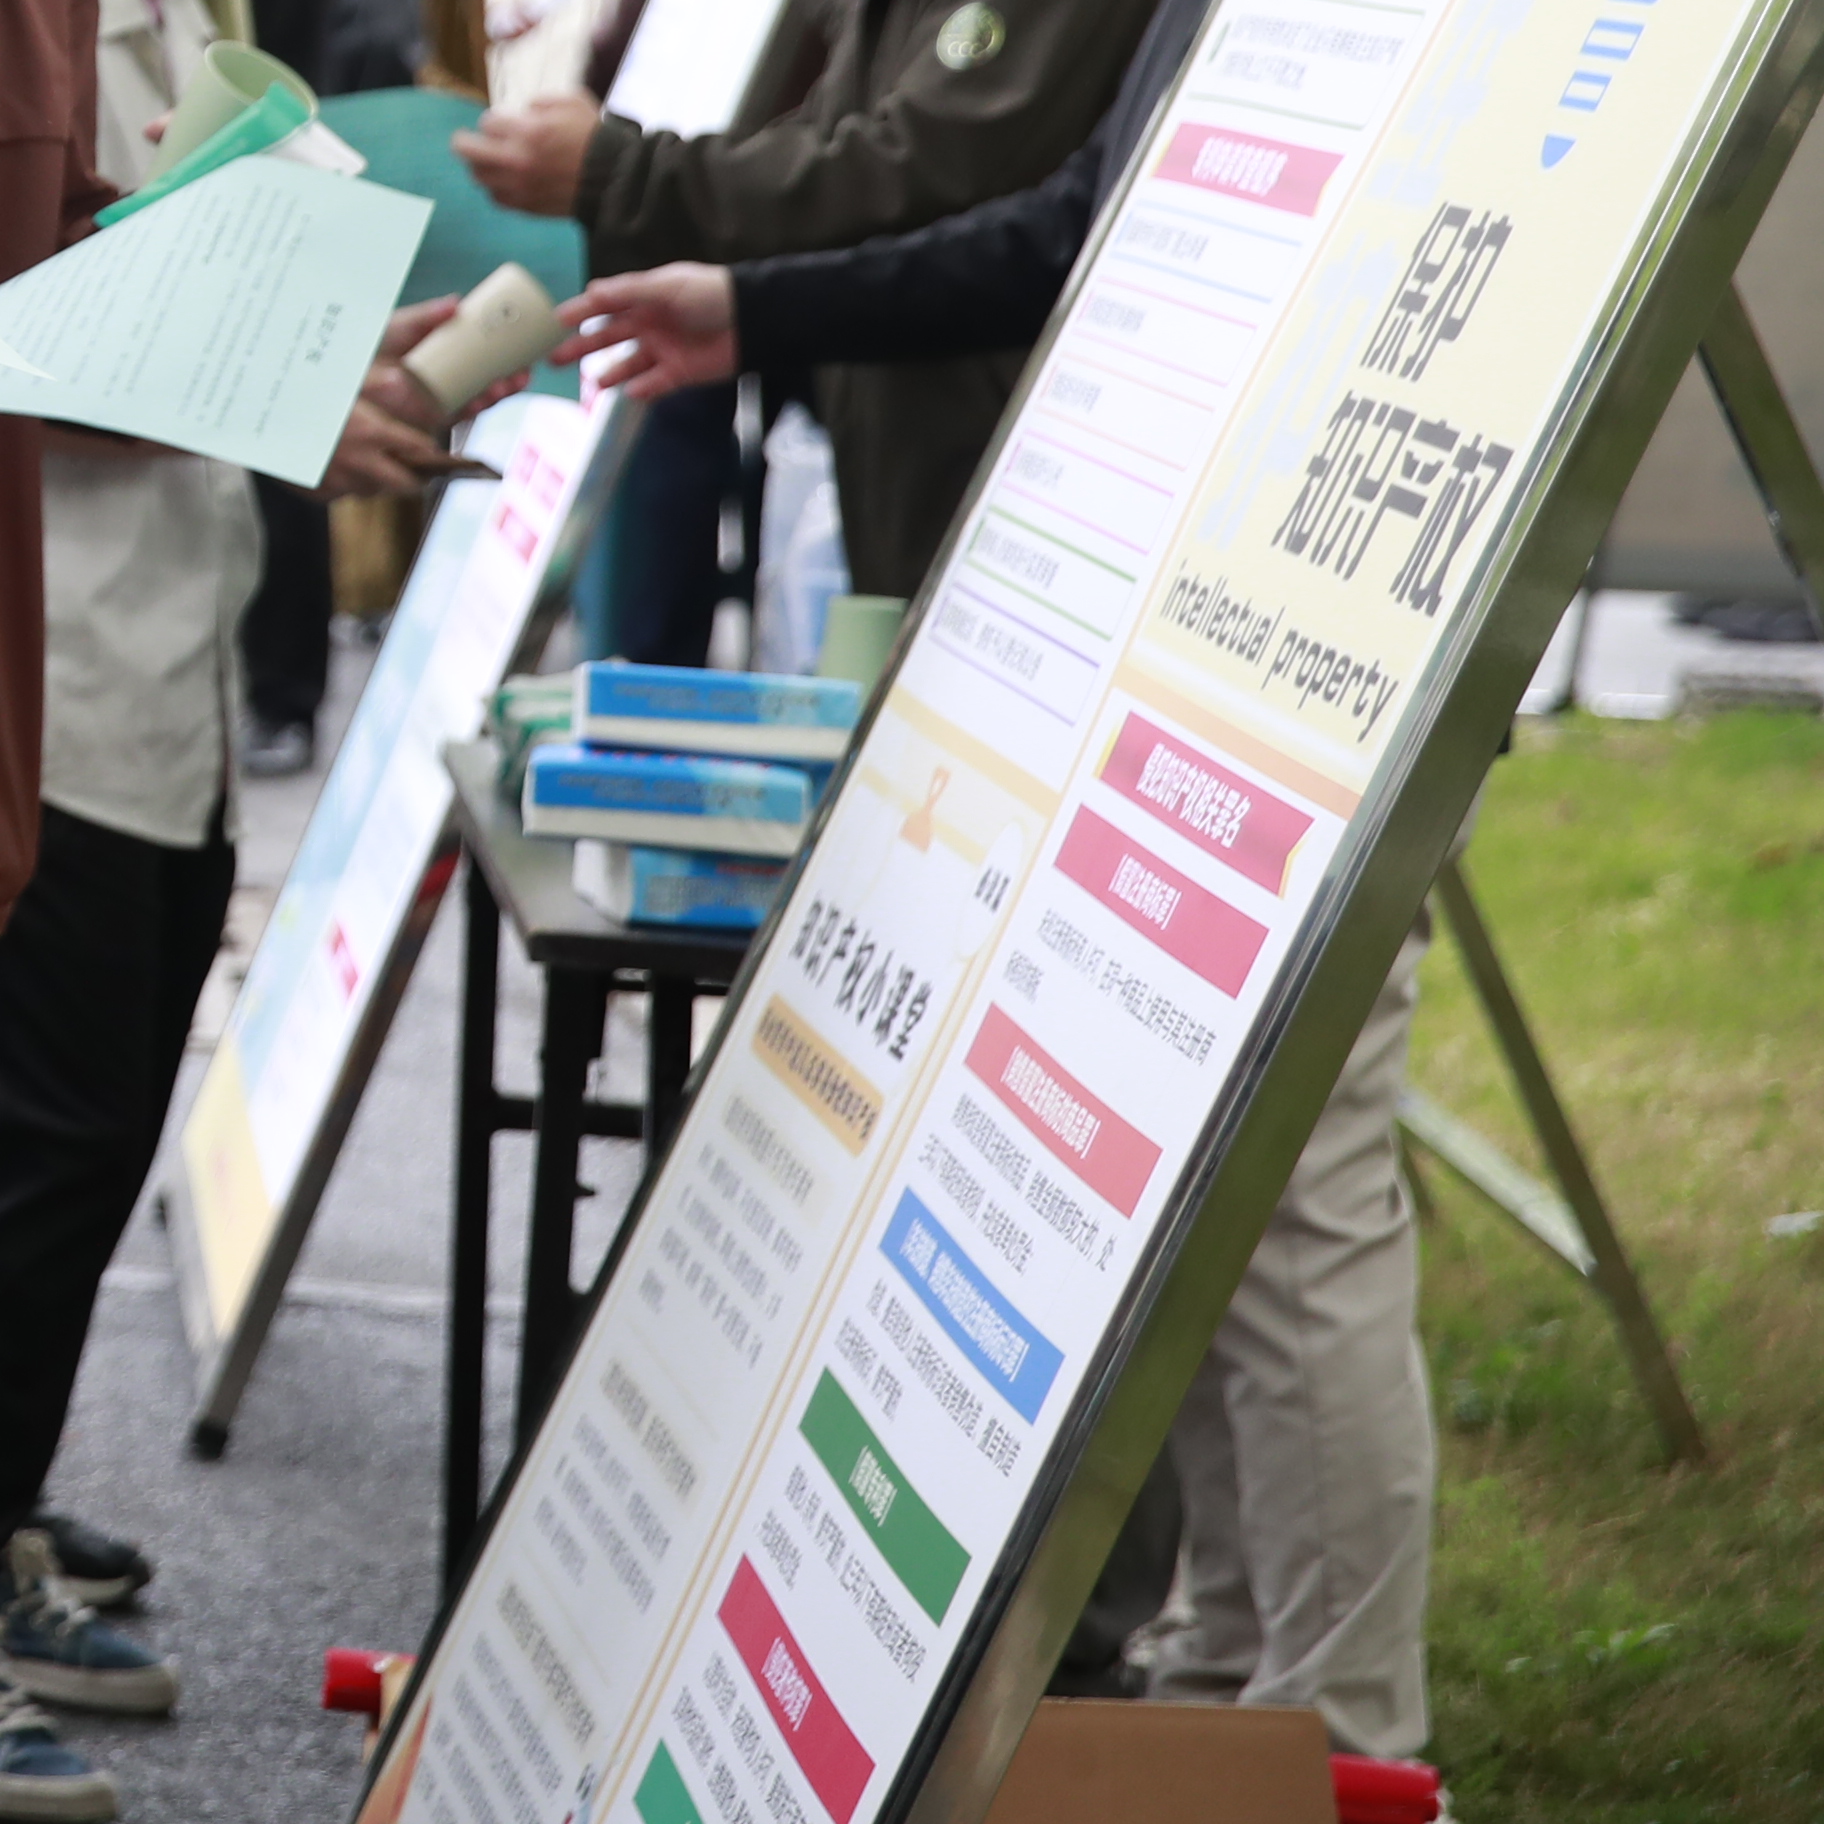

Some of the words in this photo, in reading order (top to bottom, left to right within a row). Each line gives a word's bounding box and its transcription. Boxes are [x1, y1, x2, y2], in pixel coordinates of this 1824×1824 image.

[1360, 202, 1513, 381] 保护
[1271, 390, 1514, 617] 知识产权
[1159, 560, 1286, 667] intellectual
[1261, 626, 1398, 743] property
[1134, 742, 1254, 851] 侵犯知识产权相关罪名
[787, 892, 936, 1065] 知识产权小课堂
